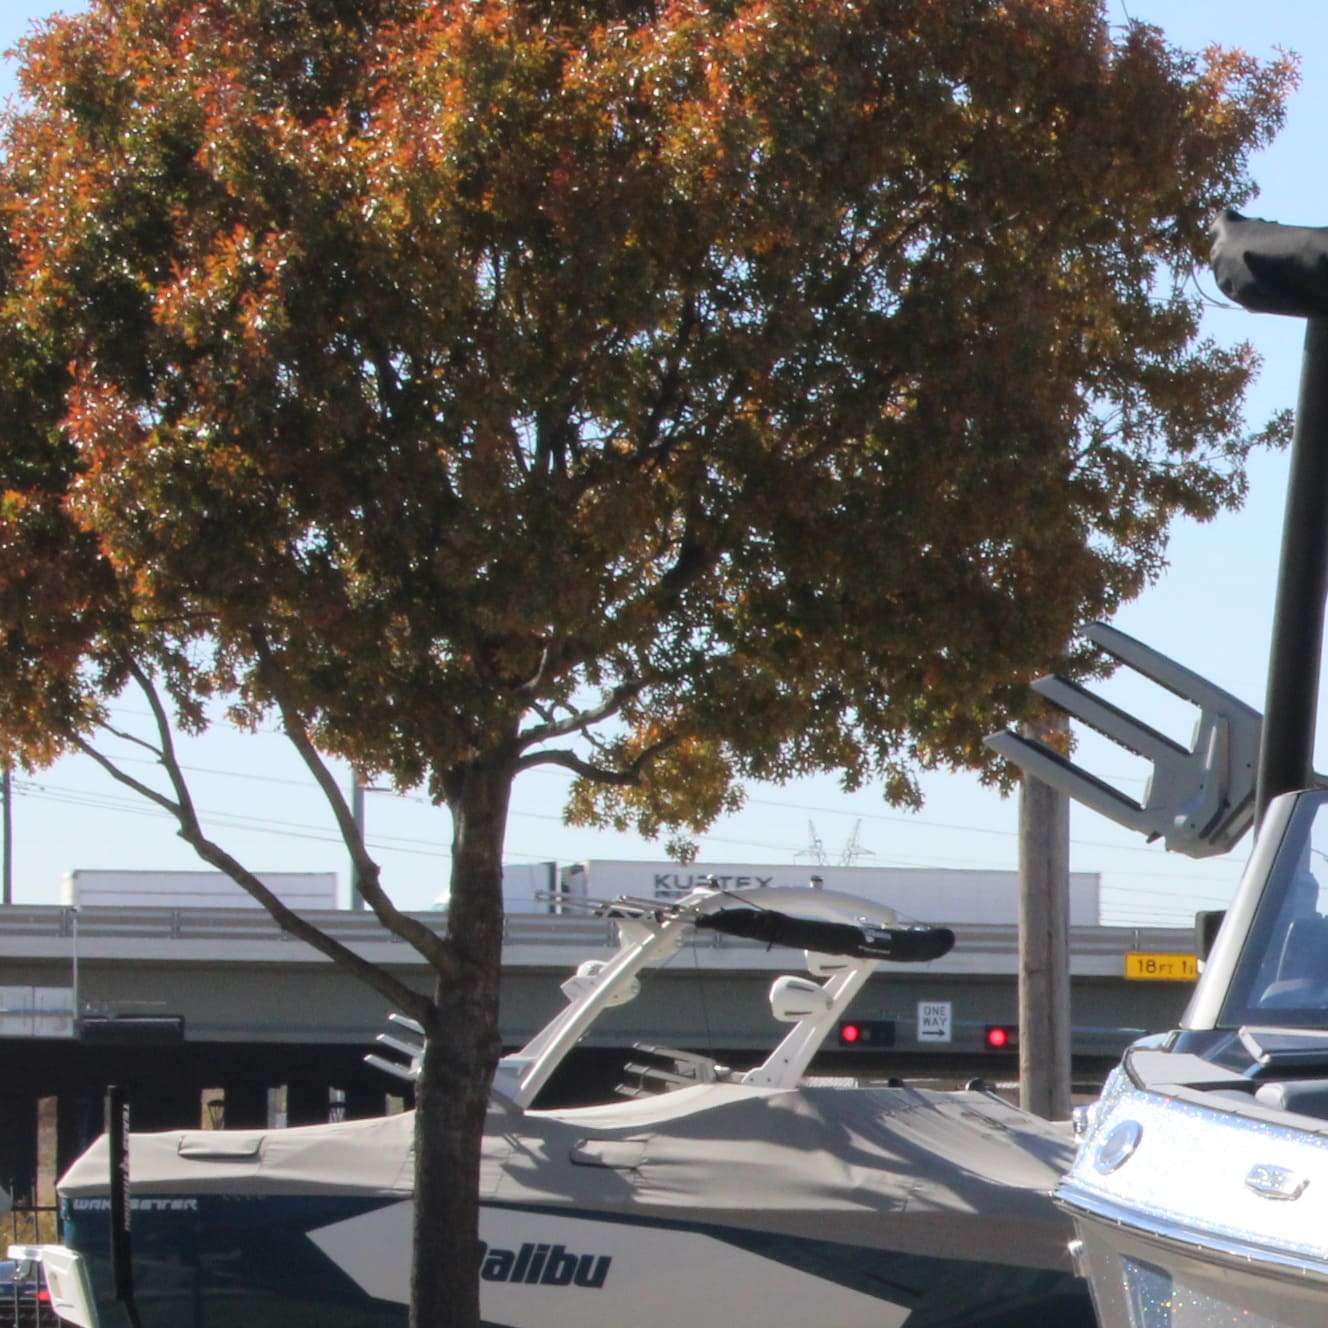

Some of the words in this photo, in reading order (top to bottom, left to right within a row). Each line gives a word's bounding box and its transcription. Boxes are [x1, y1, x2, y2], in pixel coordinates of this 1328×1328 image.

[922, 1005, 946, 1017] ONE
[922, 1017, 948, 1027] WAY
[72, 1198, 198, 1211] WAKSETTER
